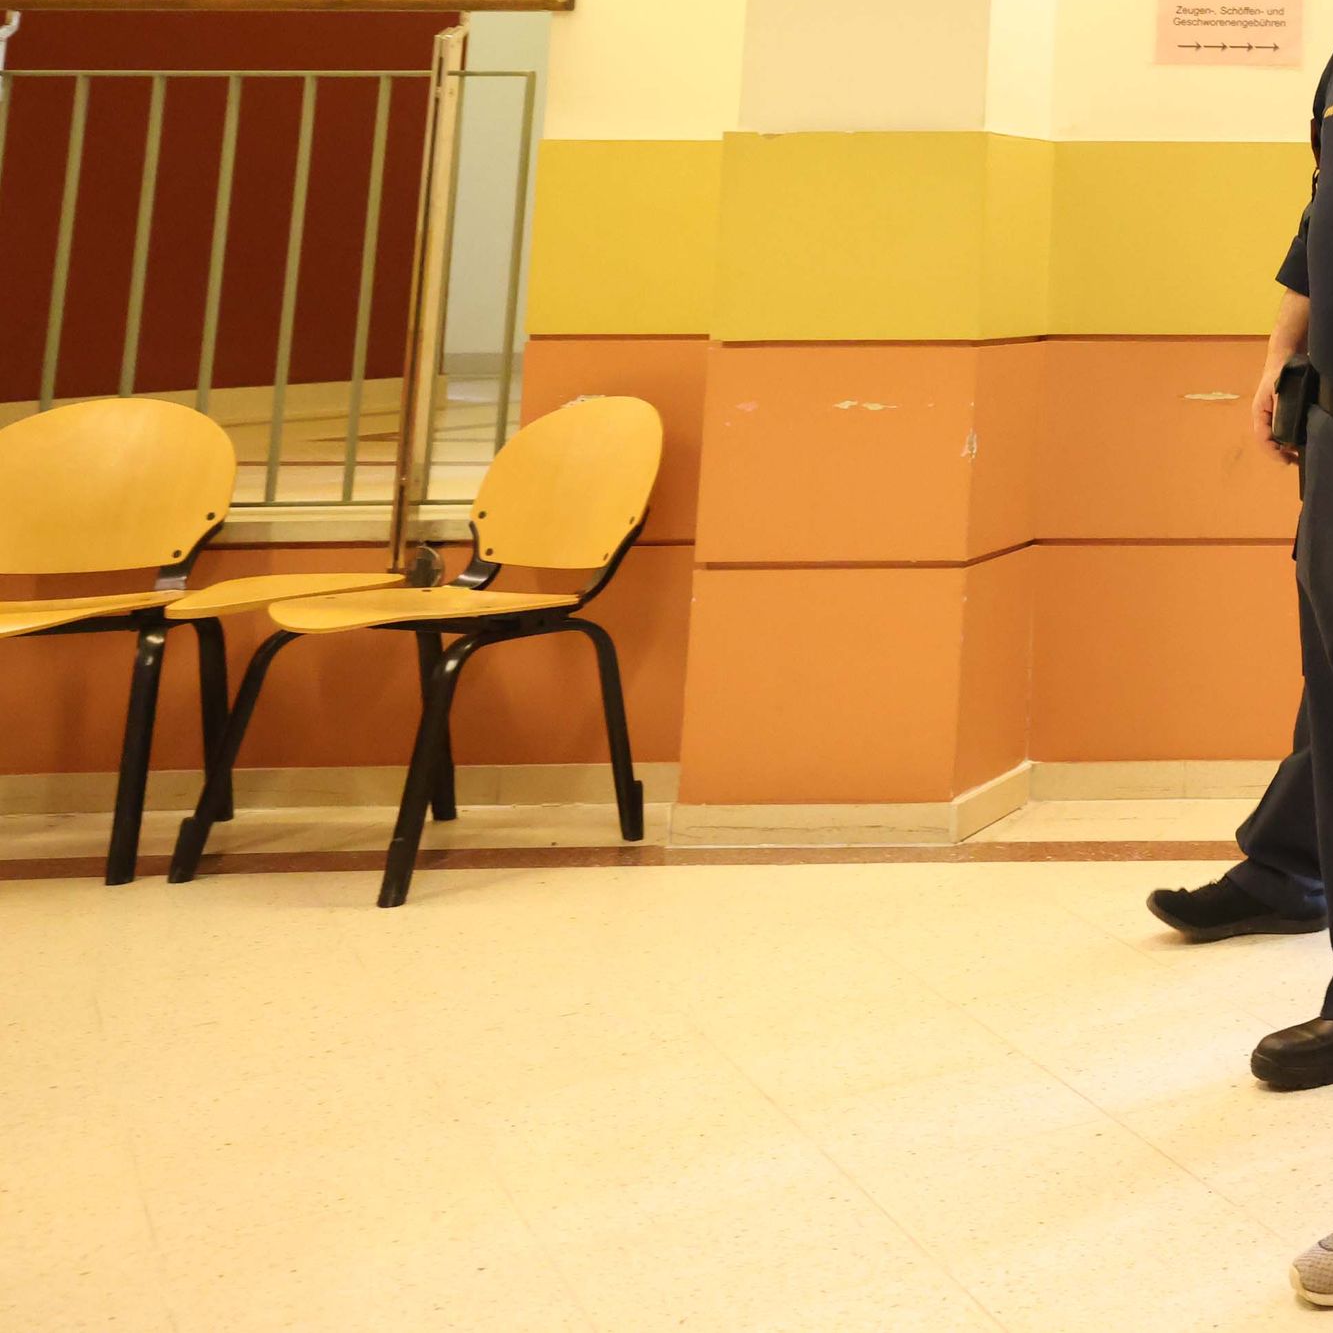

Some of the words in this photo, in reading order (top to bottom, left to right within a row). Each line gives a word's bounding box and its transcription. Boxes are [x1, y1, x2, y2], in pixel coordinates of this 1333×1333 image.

[1219, 5, 1264, 16] Schöffen-
[1266, 6, 1285, 16] und
[1172, 17, 1286, 28] Geschworenengebühren
